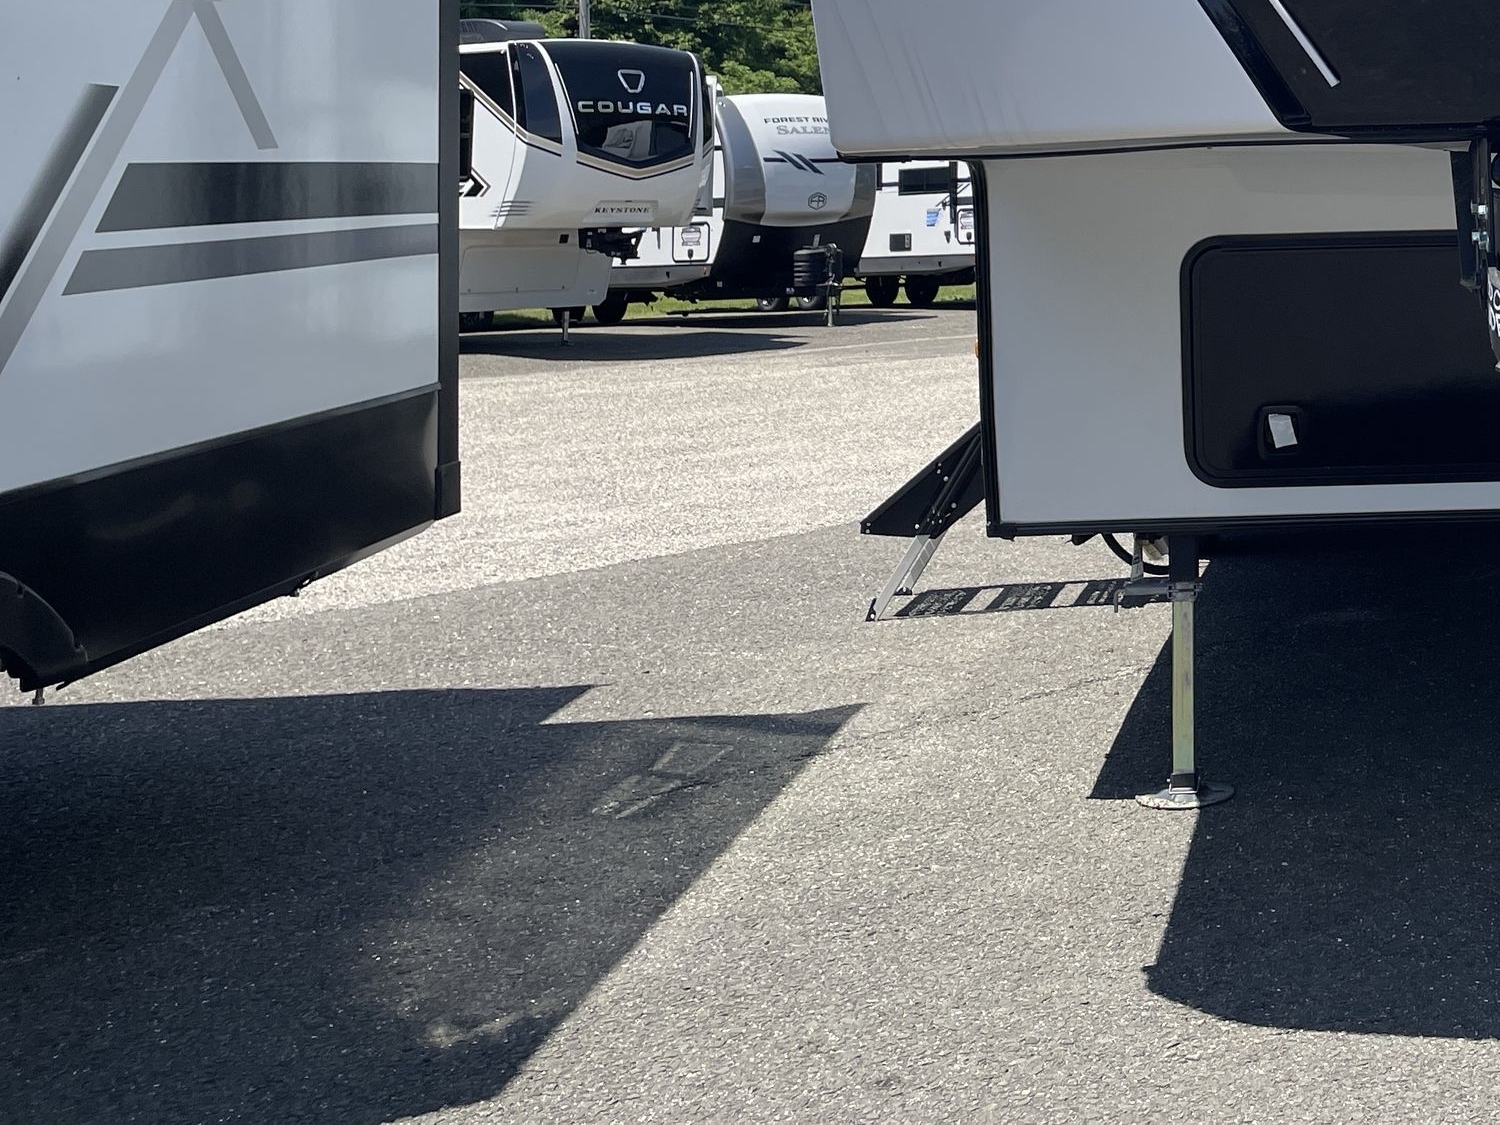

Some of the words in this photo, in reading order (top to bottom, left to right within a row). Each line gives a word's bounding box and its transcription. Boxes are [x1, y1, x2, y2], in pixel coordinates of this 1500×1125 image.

[577, 100, 688, 117] COUGAR
[763, 116, 809, 124] FOREST
[813, 116, 829, 124] RIV
[594, 206, 650, 214] KEYSTONE
